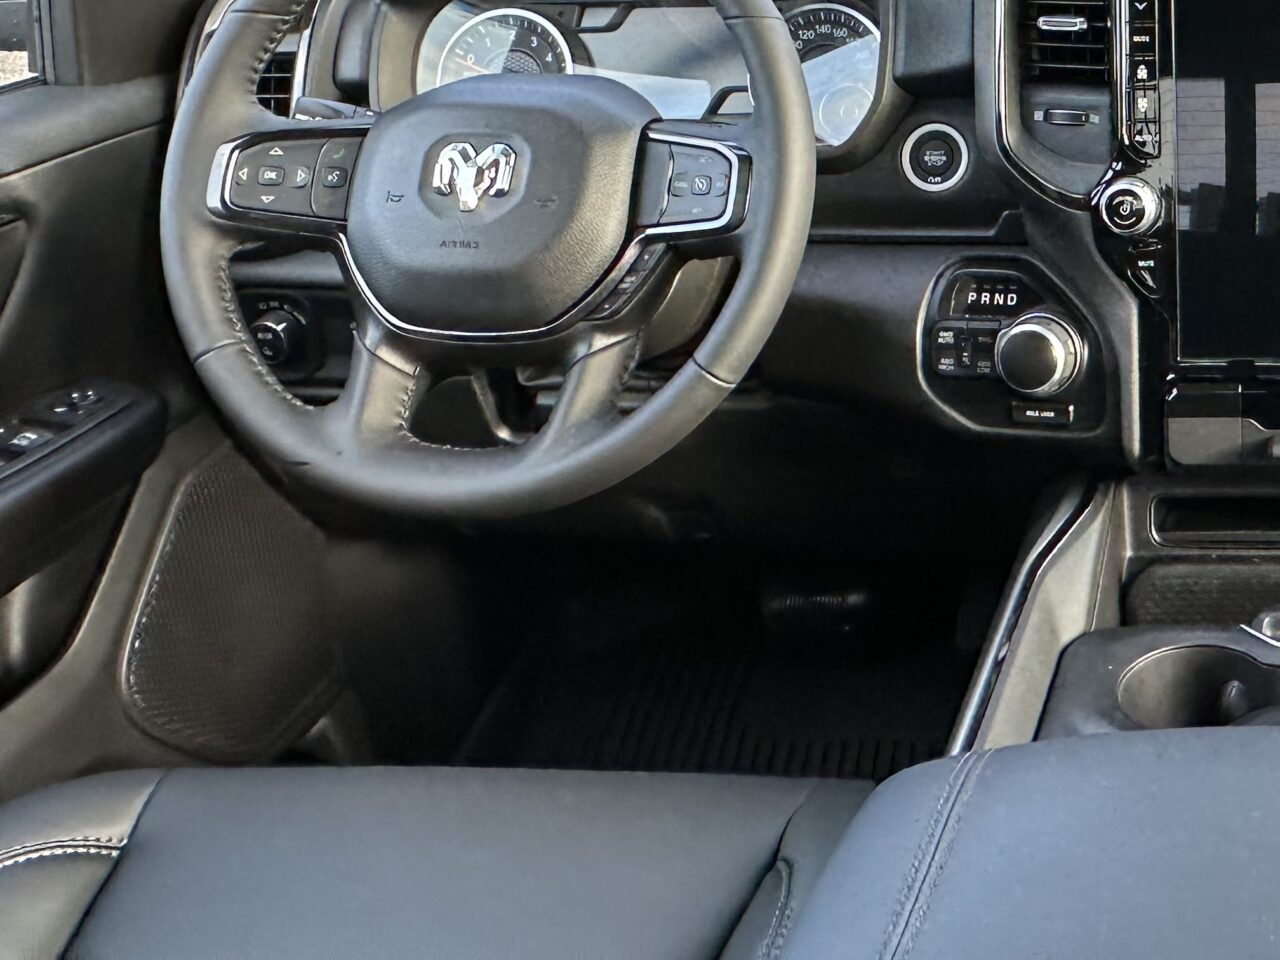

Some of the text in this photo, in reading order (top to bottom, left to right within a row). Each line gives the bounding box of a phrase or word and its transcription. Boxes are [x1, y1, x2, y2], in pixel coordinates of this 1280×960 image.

[798, 29, 815, 40] 120
[815, 23, 832, 35] 140
[509, 30, 516, 41] 2
[530, 36, 538, 47] 3
[467, 54, 475, 64] 0
[545, 52, 553, 62] 4
[263, 170, 278, 180] OK
